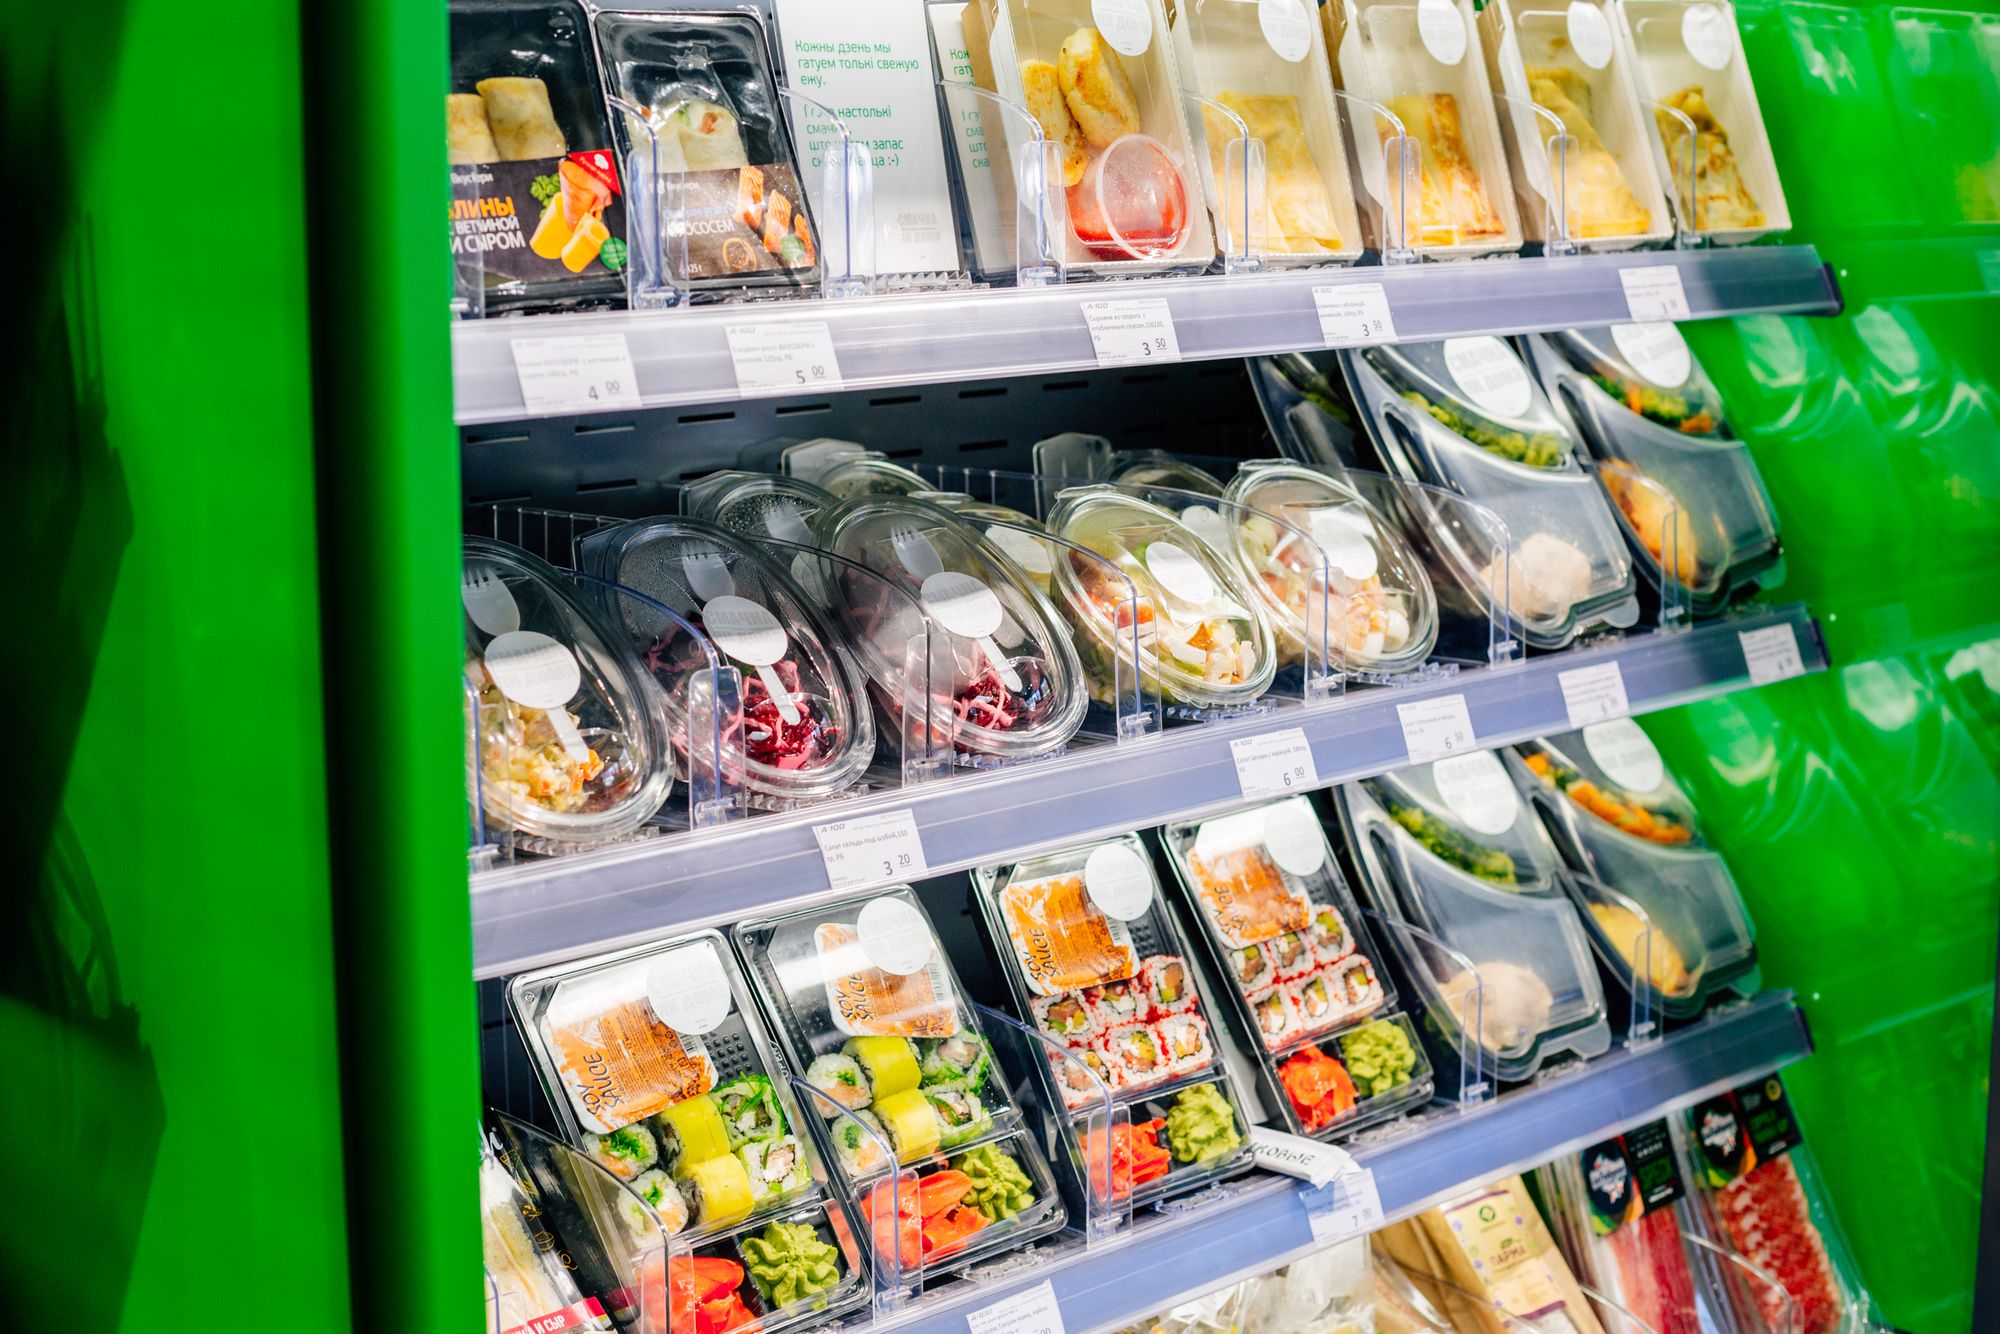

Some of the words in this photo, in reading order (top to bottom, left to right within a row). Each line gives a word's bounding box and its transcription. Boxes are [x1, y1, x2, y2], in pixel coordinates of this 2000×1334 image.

[795, 40, 835, 53] Кожны
[838, 43, 871, 54] дзень
[874, 43, 891, 53] мы
[798, 59, 836, 71] гатуем
[840, 57, 874, 69] толькі
[877, 60, 919, 72] свежую
[800, 75, 826, 88] ежу.
[838, 105, 892, 118] настолькі
[873, 140, 904, 150] запас
[464, 231, 526, 254] СЫРОМ
[1362, 324, 1370, 337] 3
[1142, 342, 1151, 356] 3
[1155, 337, 1167, 348] 50
[796, 370, 806, 385] 5
[811, 365, 825, 376] 00
[588, 385, 599, 400] 4
[605, 380, 621, 392] 00
[1445, 736, 1453, 750] 6
[1283, 772, 1292, 786] 6
[1294, 766, 1305, 777] 00
[883, 861, 894, 876] 3
[898, 853, 911, 866] 20
[1029, 927, 1060, 977] SAUCE
[1022, 951, 1043, 981] SOY
[836, 988, 856, 1019] SOY
[583, 1051, 625, 1109] SAUCE
[577, 1083, 601, 1115] SOY
[1352, 1215, 1358, 1228] 7
[543, 1315, 565, 1333] СЫР
